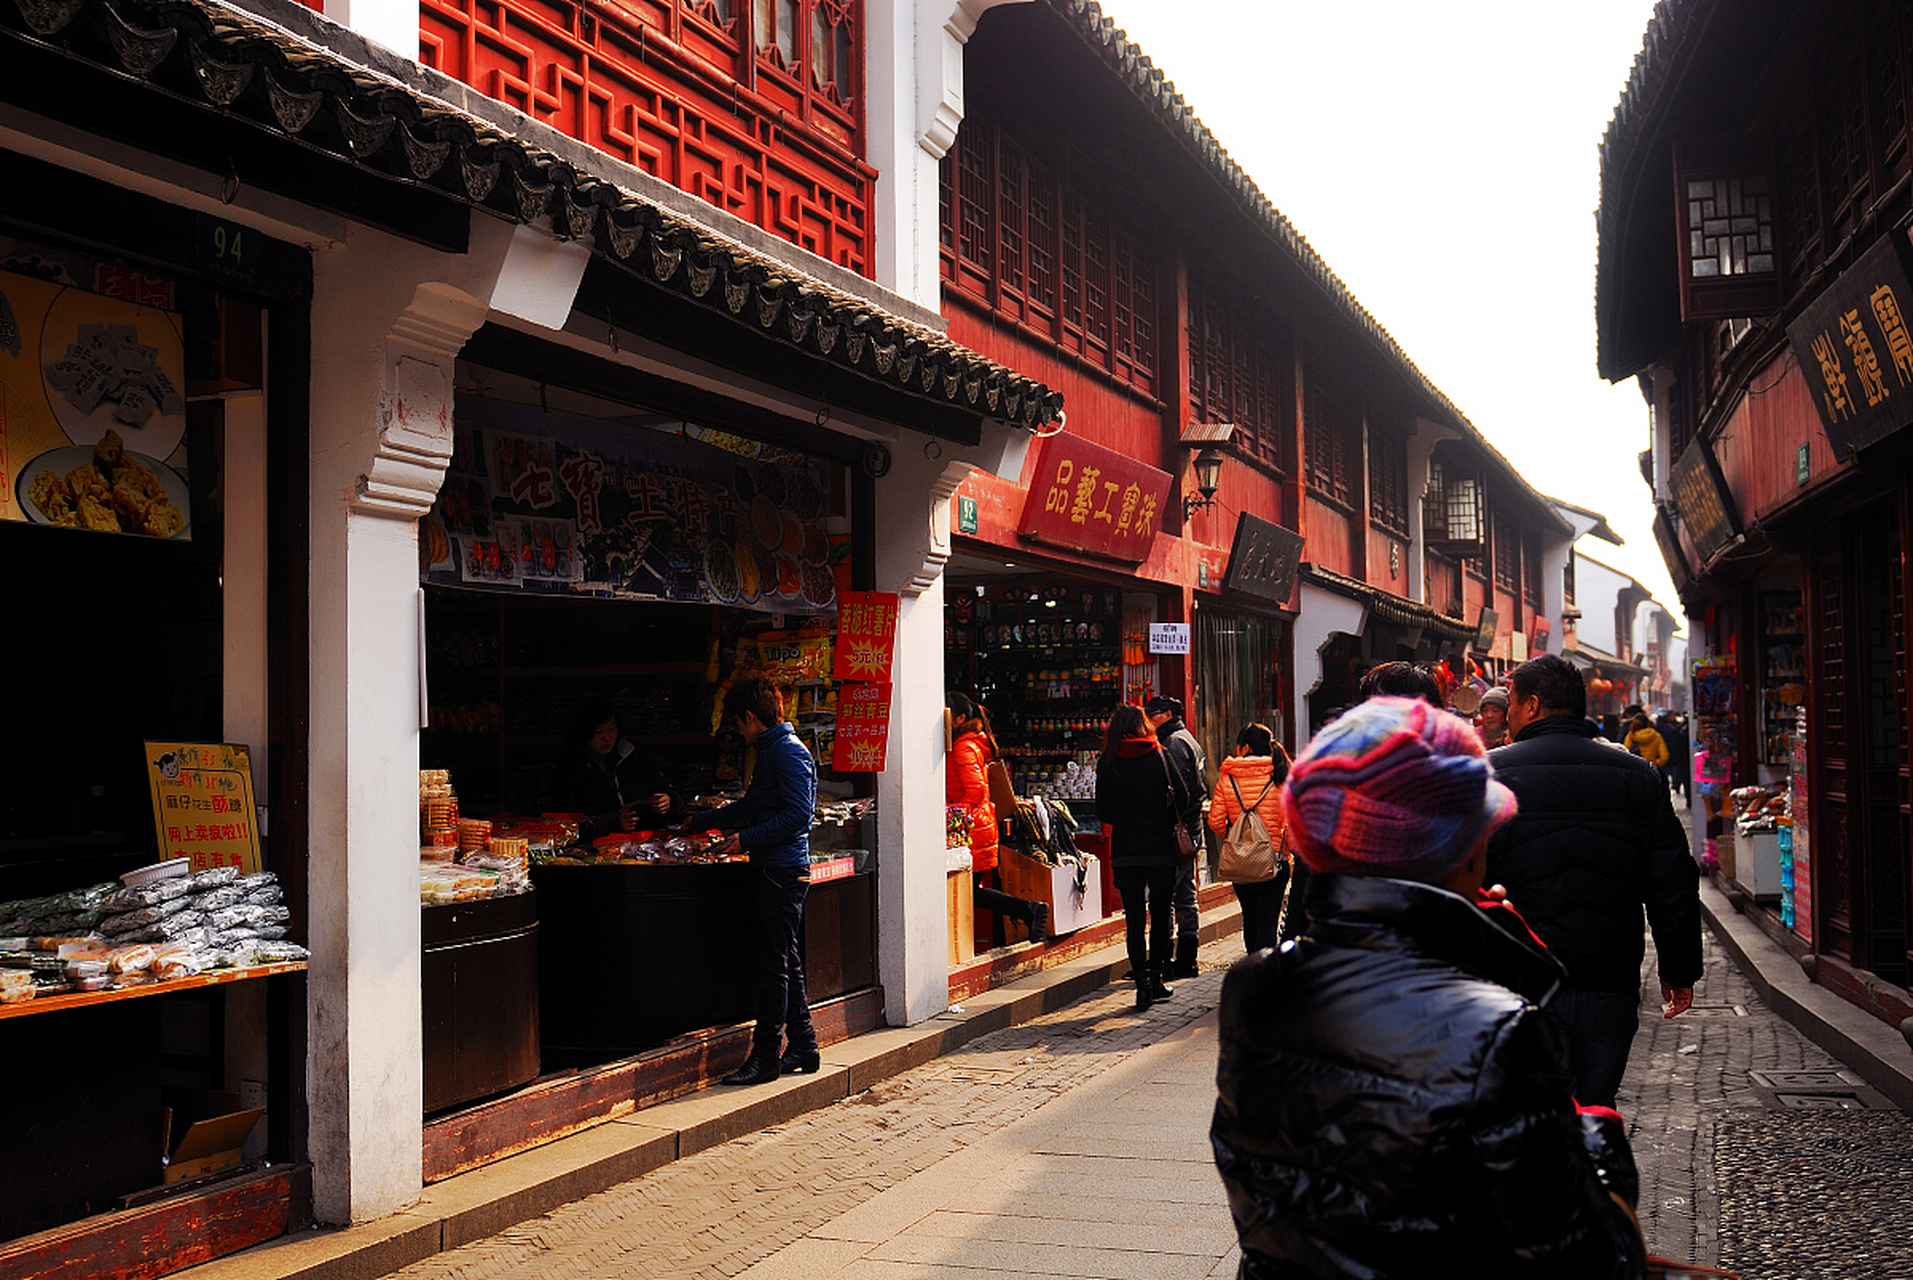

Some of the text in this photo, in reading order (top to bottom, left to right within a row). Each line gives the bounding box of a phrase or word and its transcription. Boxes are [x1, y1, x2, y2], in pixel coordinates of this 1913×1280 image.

[214, 226, 242, 264] 94
[765, 647, 801, 663] Tipo
[168, 822, 248, 842] 网上卖疯啦!!
